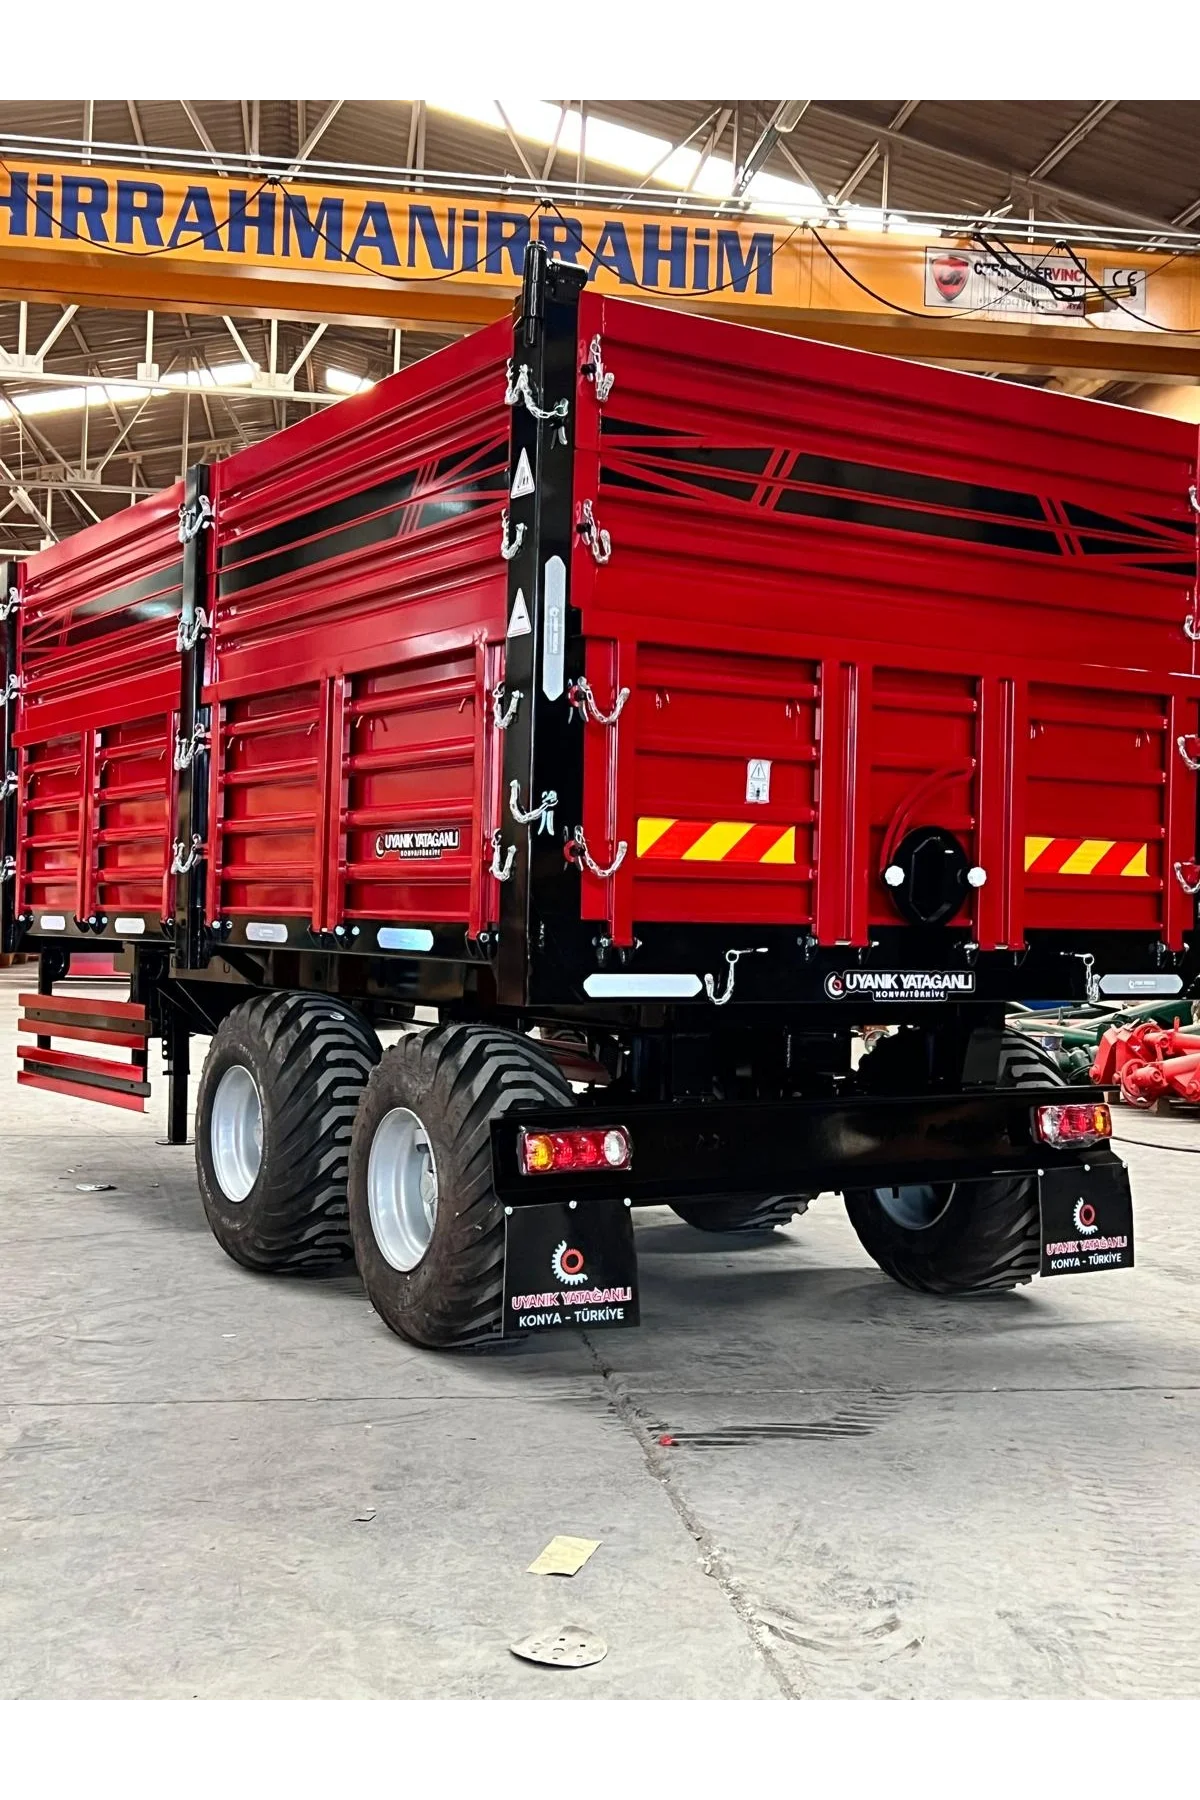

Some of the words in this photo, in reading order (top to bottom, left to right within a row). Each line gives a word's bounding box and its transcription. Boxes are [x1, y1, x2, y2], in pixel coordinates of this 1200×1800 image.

[846, 973, 898, 989] UYANIK
[1046, 1240, 1079, 1256] UYANIK
[1051, 1258, 1080, 1270] KONYA
[1088, 1251, 1122, 1265] TÜRKİYE
[511, 1292, 560, 1311] UYANIK
[519, 1312, 562, 1328] KONYA
[574, 1306, 625, 1323] TÜRKİYE
